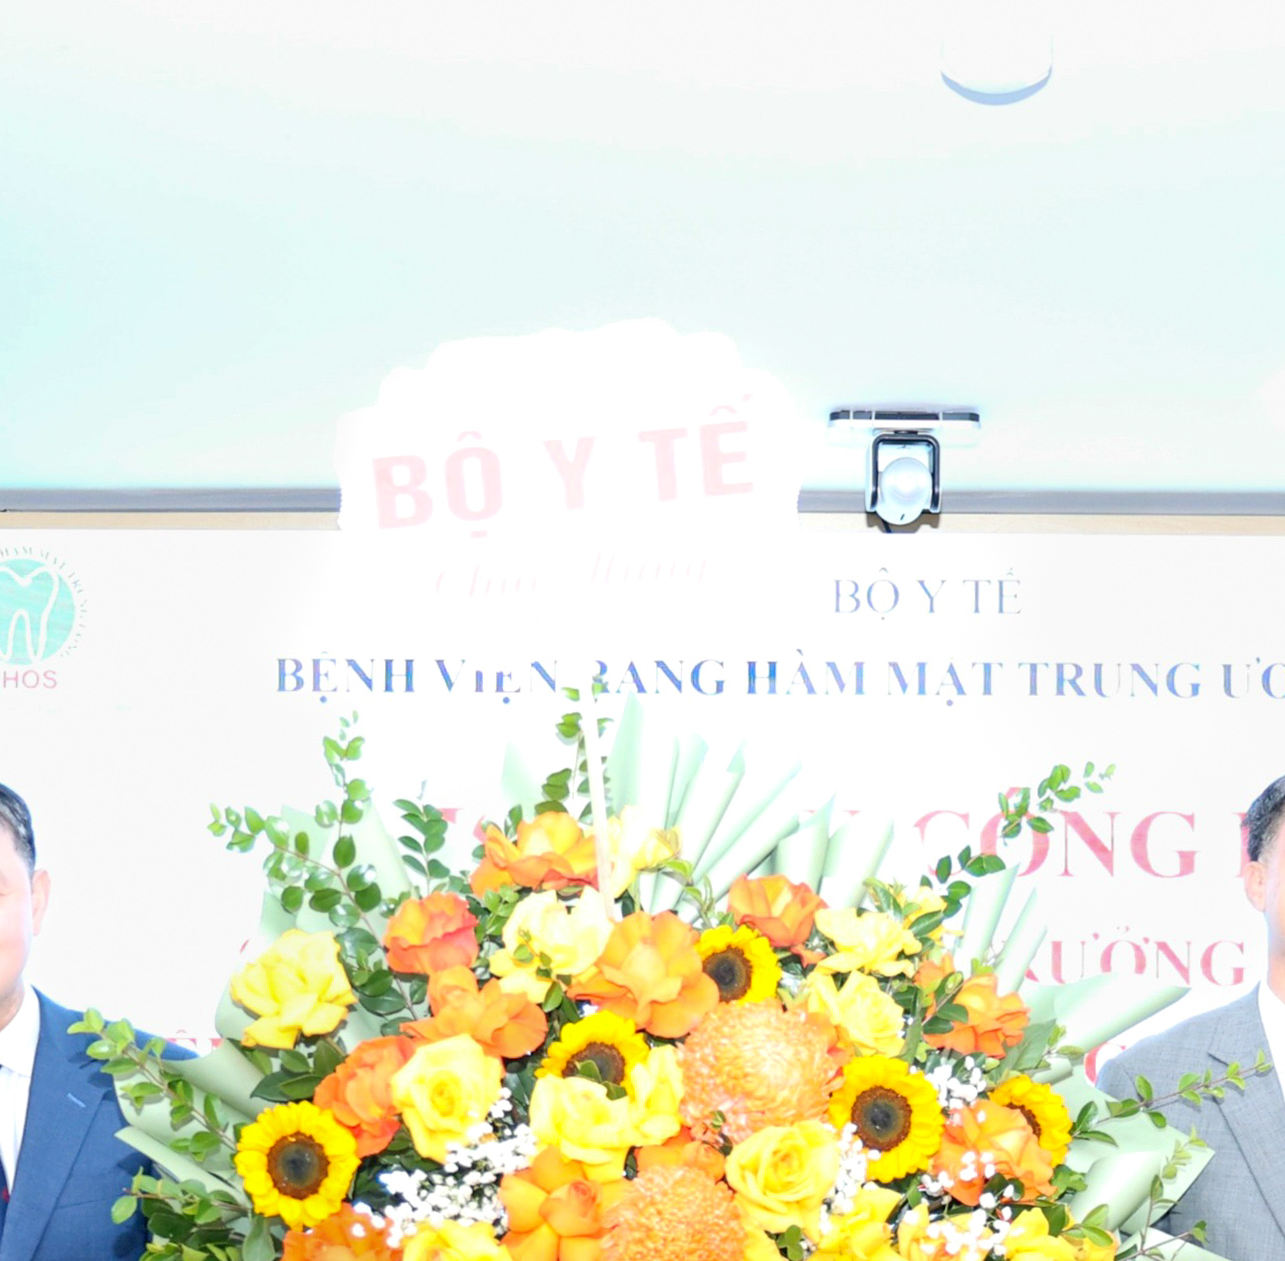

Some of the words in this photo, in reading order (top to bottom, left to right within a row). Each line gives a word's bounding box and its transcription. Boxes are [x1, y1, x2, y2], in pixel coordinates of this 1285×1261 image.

[371, 430, 504, 539] BỘ
[541, 435, 598, 511] Y
[636, 392, 755, 503] TẾ
[834, 566, 900, 621] BỘ
[915, 579, 947, 614] Y
[962, 567, 1022, 614] TẾ
[276, 650, 415, 705] BỆNH
[746, 648, 866, 696] HÀM
[1017, 661, 1202, 699] TRUNG
[1024, 925, 1247, 986] ƯỞNG
